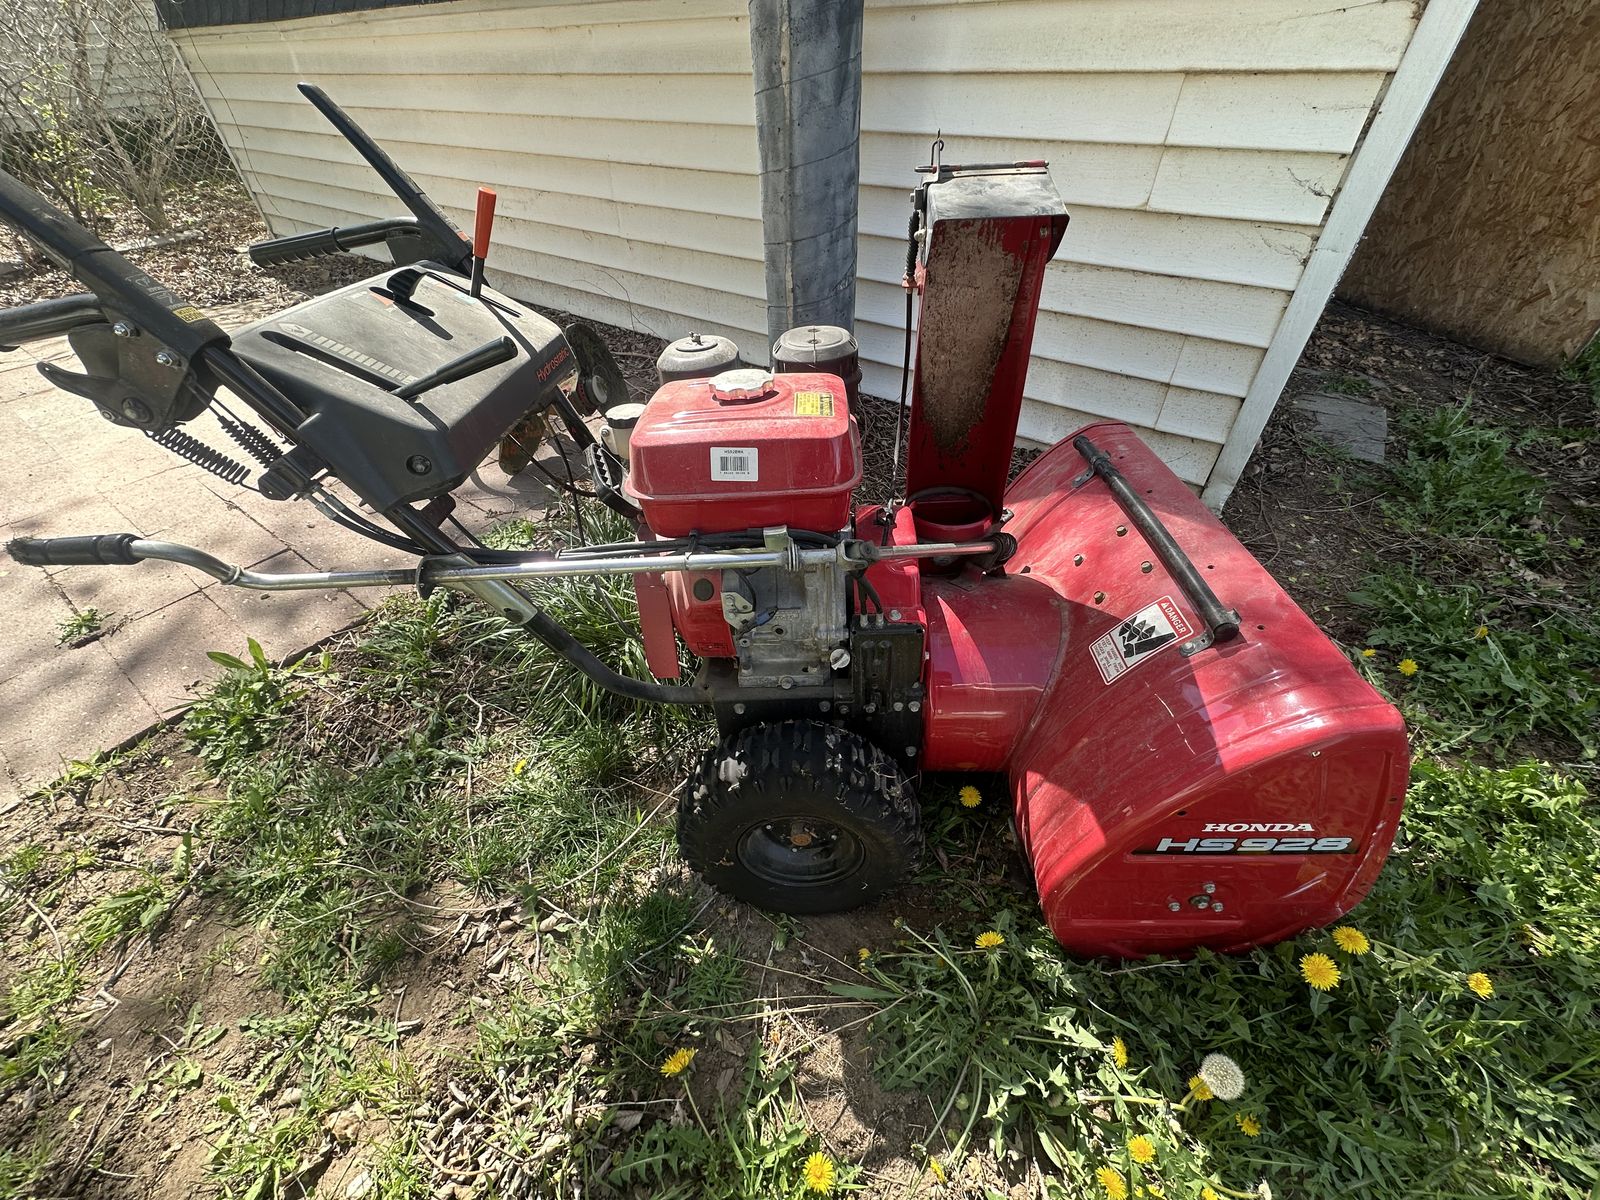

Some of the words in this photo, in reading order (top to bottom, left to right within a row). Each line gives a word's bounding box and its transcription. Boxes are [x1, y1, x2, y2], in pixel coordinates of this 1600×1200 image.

[536, 347, 570, 382] Hydrostatic
[1165, 607, 1186, 634] DANGER
[1202, 823, 1315, 832] HONDA
[1156, 838, 1352, 851] HS928
